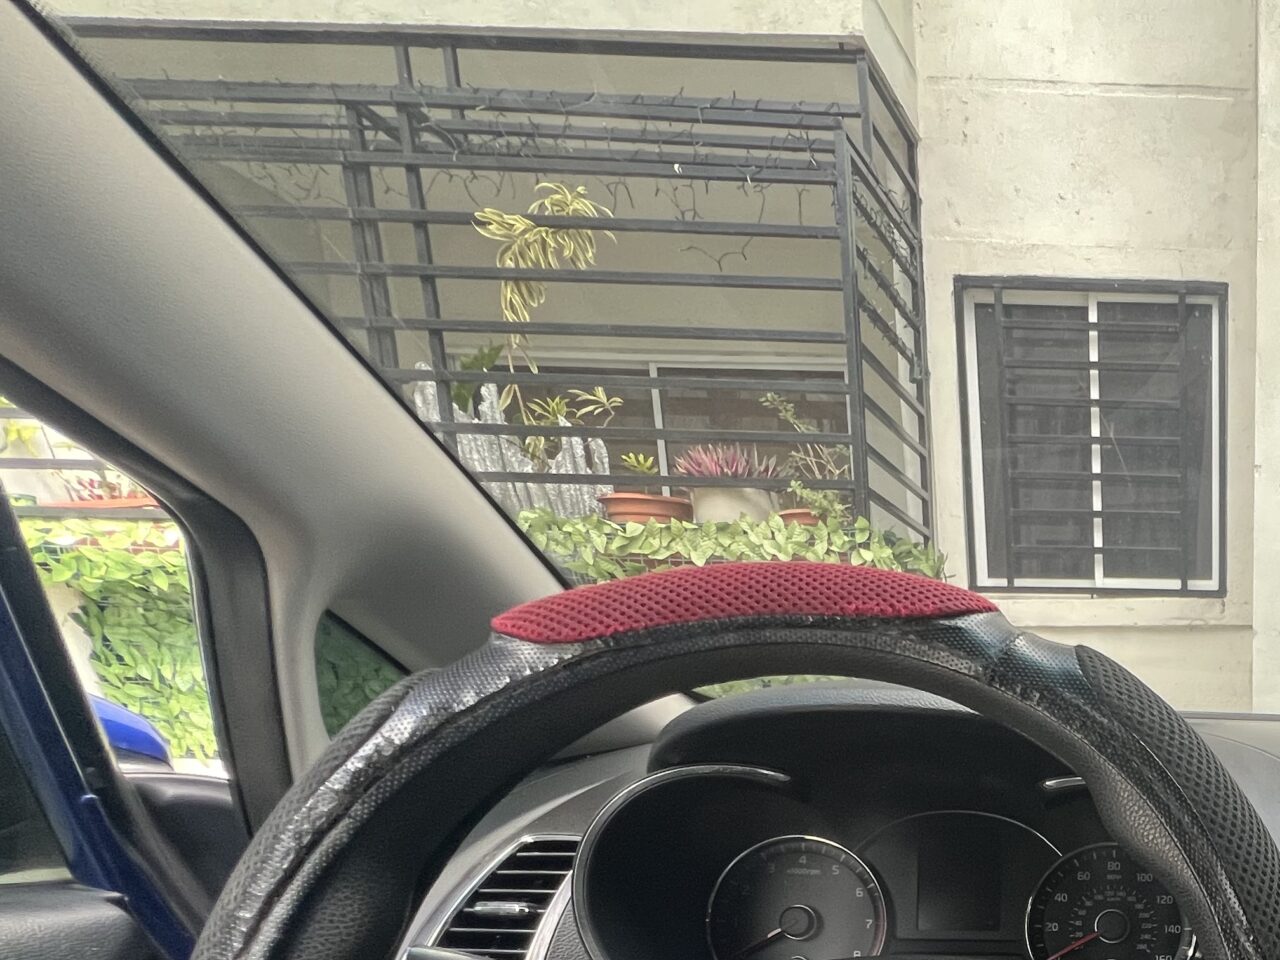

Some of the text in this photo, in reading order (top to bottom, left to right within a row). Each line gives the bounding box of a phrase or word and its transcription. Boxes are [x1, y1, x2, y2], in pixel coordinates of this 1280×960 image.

[799, 856, 806, 864] 4
[832, 865, 839, 875] 5
[1107, 861, 1121, 871] 80
[1077, 871, 1091, 881] 60
[1136, 873, 1153, 882] 100
[855, 887, 863, 897] 6
[1054, 893, 1068, 902] 40
[1156, 895, 1174, 905] 120
[865, 919, 873, 929] 7
[1045, 922, 1059, 932] 20
[1164, 924, 1182, 934] 140
